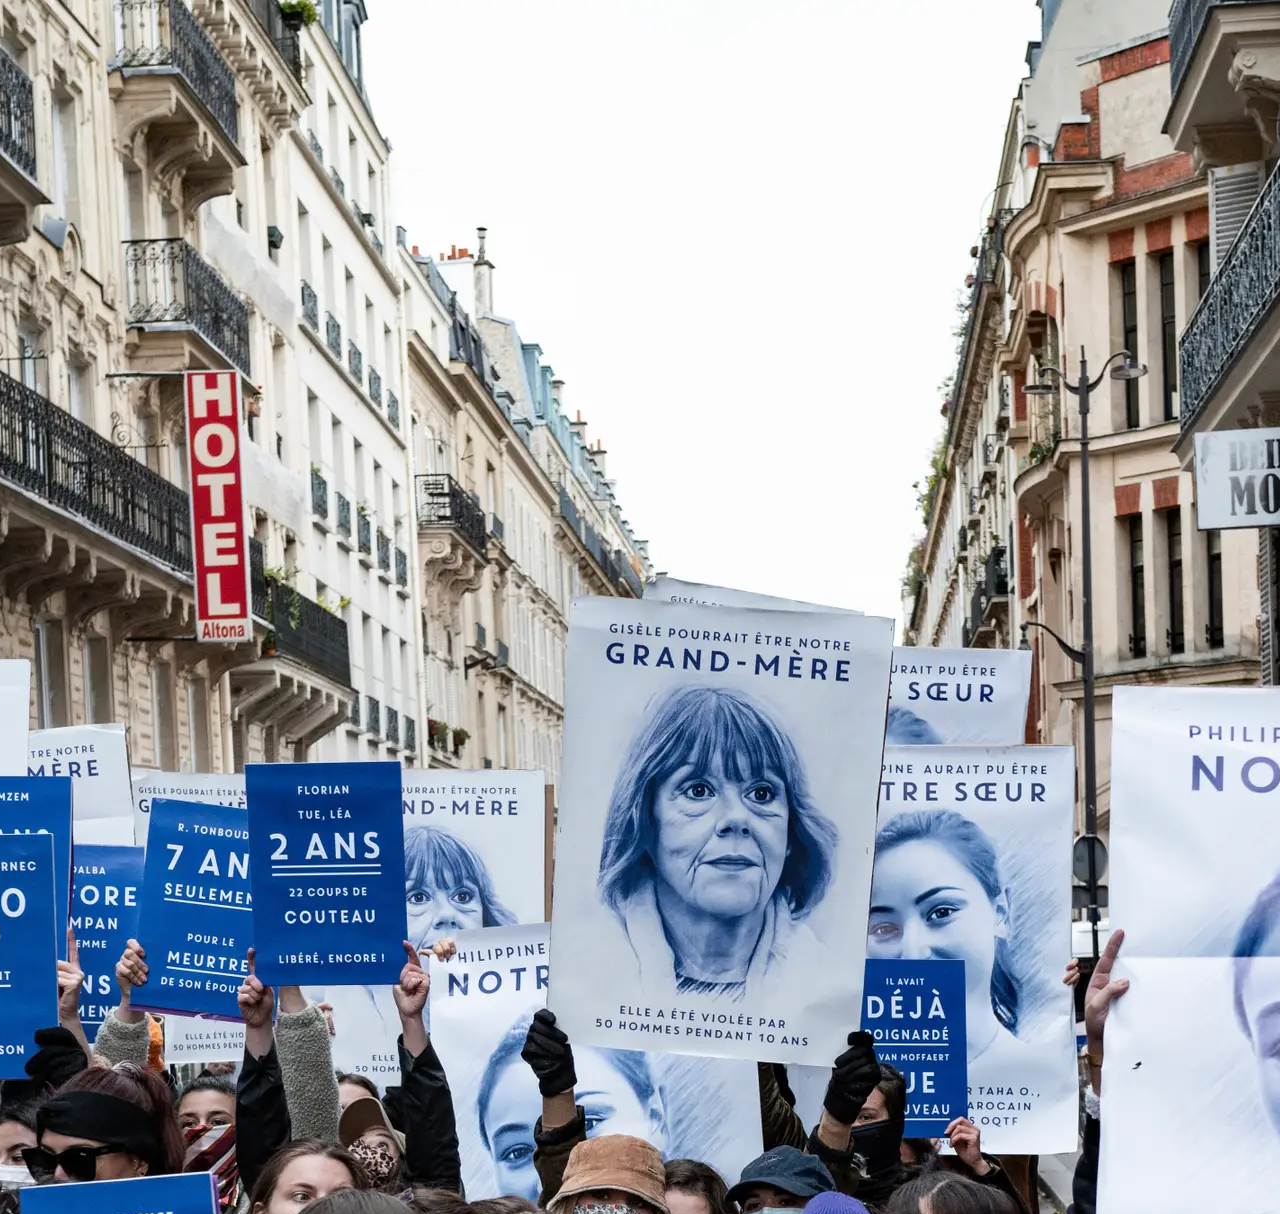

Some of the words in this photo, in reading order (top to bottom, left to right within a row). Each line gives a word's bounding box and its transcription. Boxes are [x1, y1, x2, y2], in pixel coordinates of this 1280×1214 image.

[191, 373, 241, 616] HOTEL
[202, 621, 245, 639] Altona
[609, 621, 662, 637] GISÈLE
[668, 627, 748, 644] POURRAIT
[755, 632, 792, 647] ÊTRE
[799, 638, 851, 651] NOTRE
[606, 642, 851, 682] GRAND-MÈRE
[924, 765, 979, 775] AURAIT
[987, 765, 1005, 775] PU
[1012, 763, 1047, 775] ÊTRE
[297, 785, 349, 795] FLORIAN
[955, 782, 1046, 802] SŒUR
[298, 810, 325, 820] TUE,
[330, 808, 351, 819] LÉA
[178, 823, 189, 832] R.
[194, 825, 249, 840] TONBOUD
[270, 833, 289, 860] 2
[305, 831, 381, 860] ANS
[167, 843, 184, 871] 7
[289, 888, 303, 897] 22
[307, 887, 349, 897] COUPS
[353, 887, 368, 896] DE
[284, 909, 376, 924] COUTEAU
[187, 933, 218, 945] POUR
[222, 937, 235, 947] LE
[167, 950, 248, 973] MEURTRE
[279, 951, 324, 965] LIBÉRÉ,
[328, 953, 377, 964] ENCORE
[381, 953, 385, 963] !
[160, 976, 174, 986] DE
[178, 978, 201, 990] SON
[885, 977, 896, 986] IL
[898, 977, 924, 986] AVAIT
[866, 989, 946, 1019] DÉJÀ
[619, 1005, 651, 1017] ELLE
[656, 1009, 665, 1018] A
[671, 1008, 696, 1021] ÉTÉ
[701, 1012, 753, 1026] VIOLÉE
[759, 1018, 787, 1029] PAR
[595, 1018, 613, 1028] 50
[619, 1020, 681, 1036] HOMMES
[686, 1027, 753, 1042] PENDANT
[759, 1033, 775, 1044] 10
[780, 1036, 809, 1047] ANS
[901, 1053, 950, 1062] MOFFAERT
